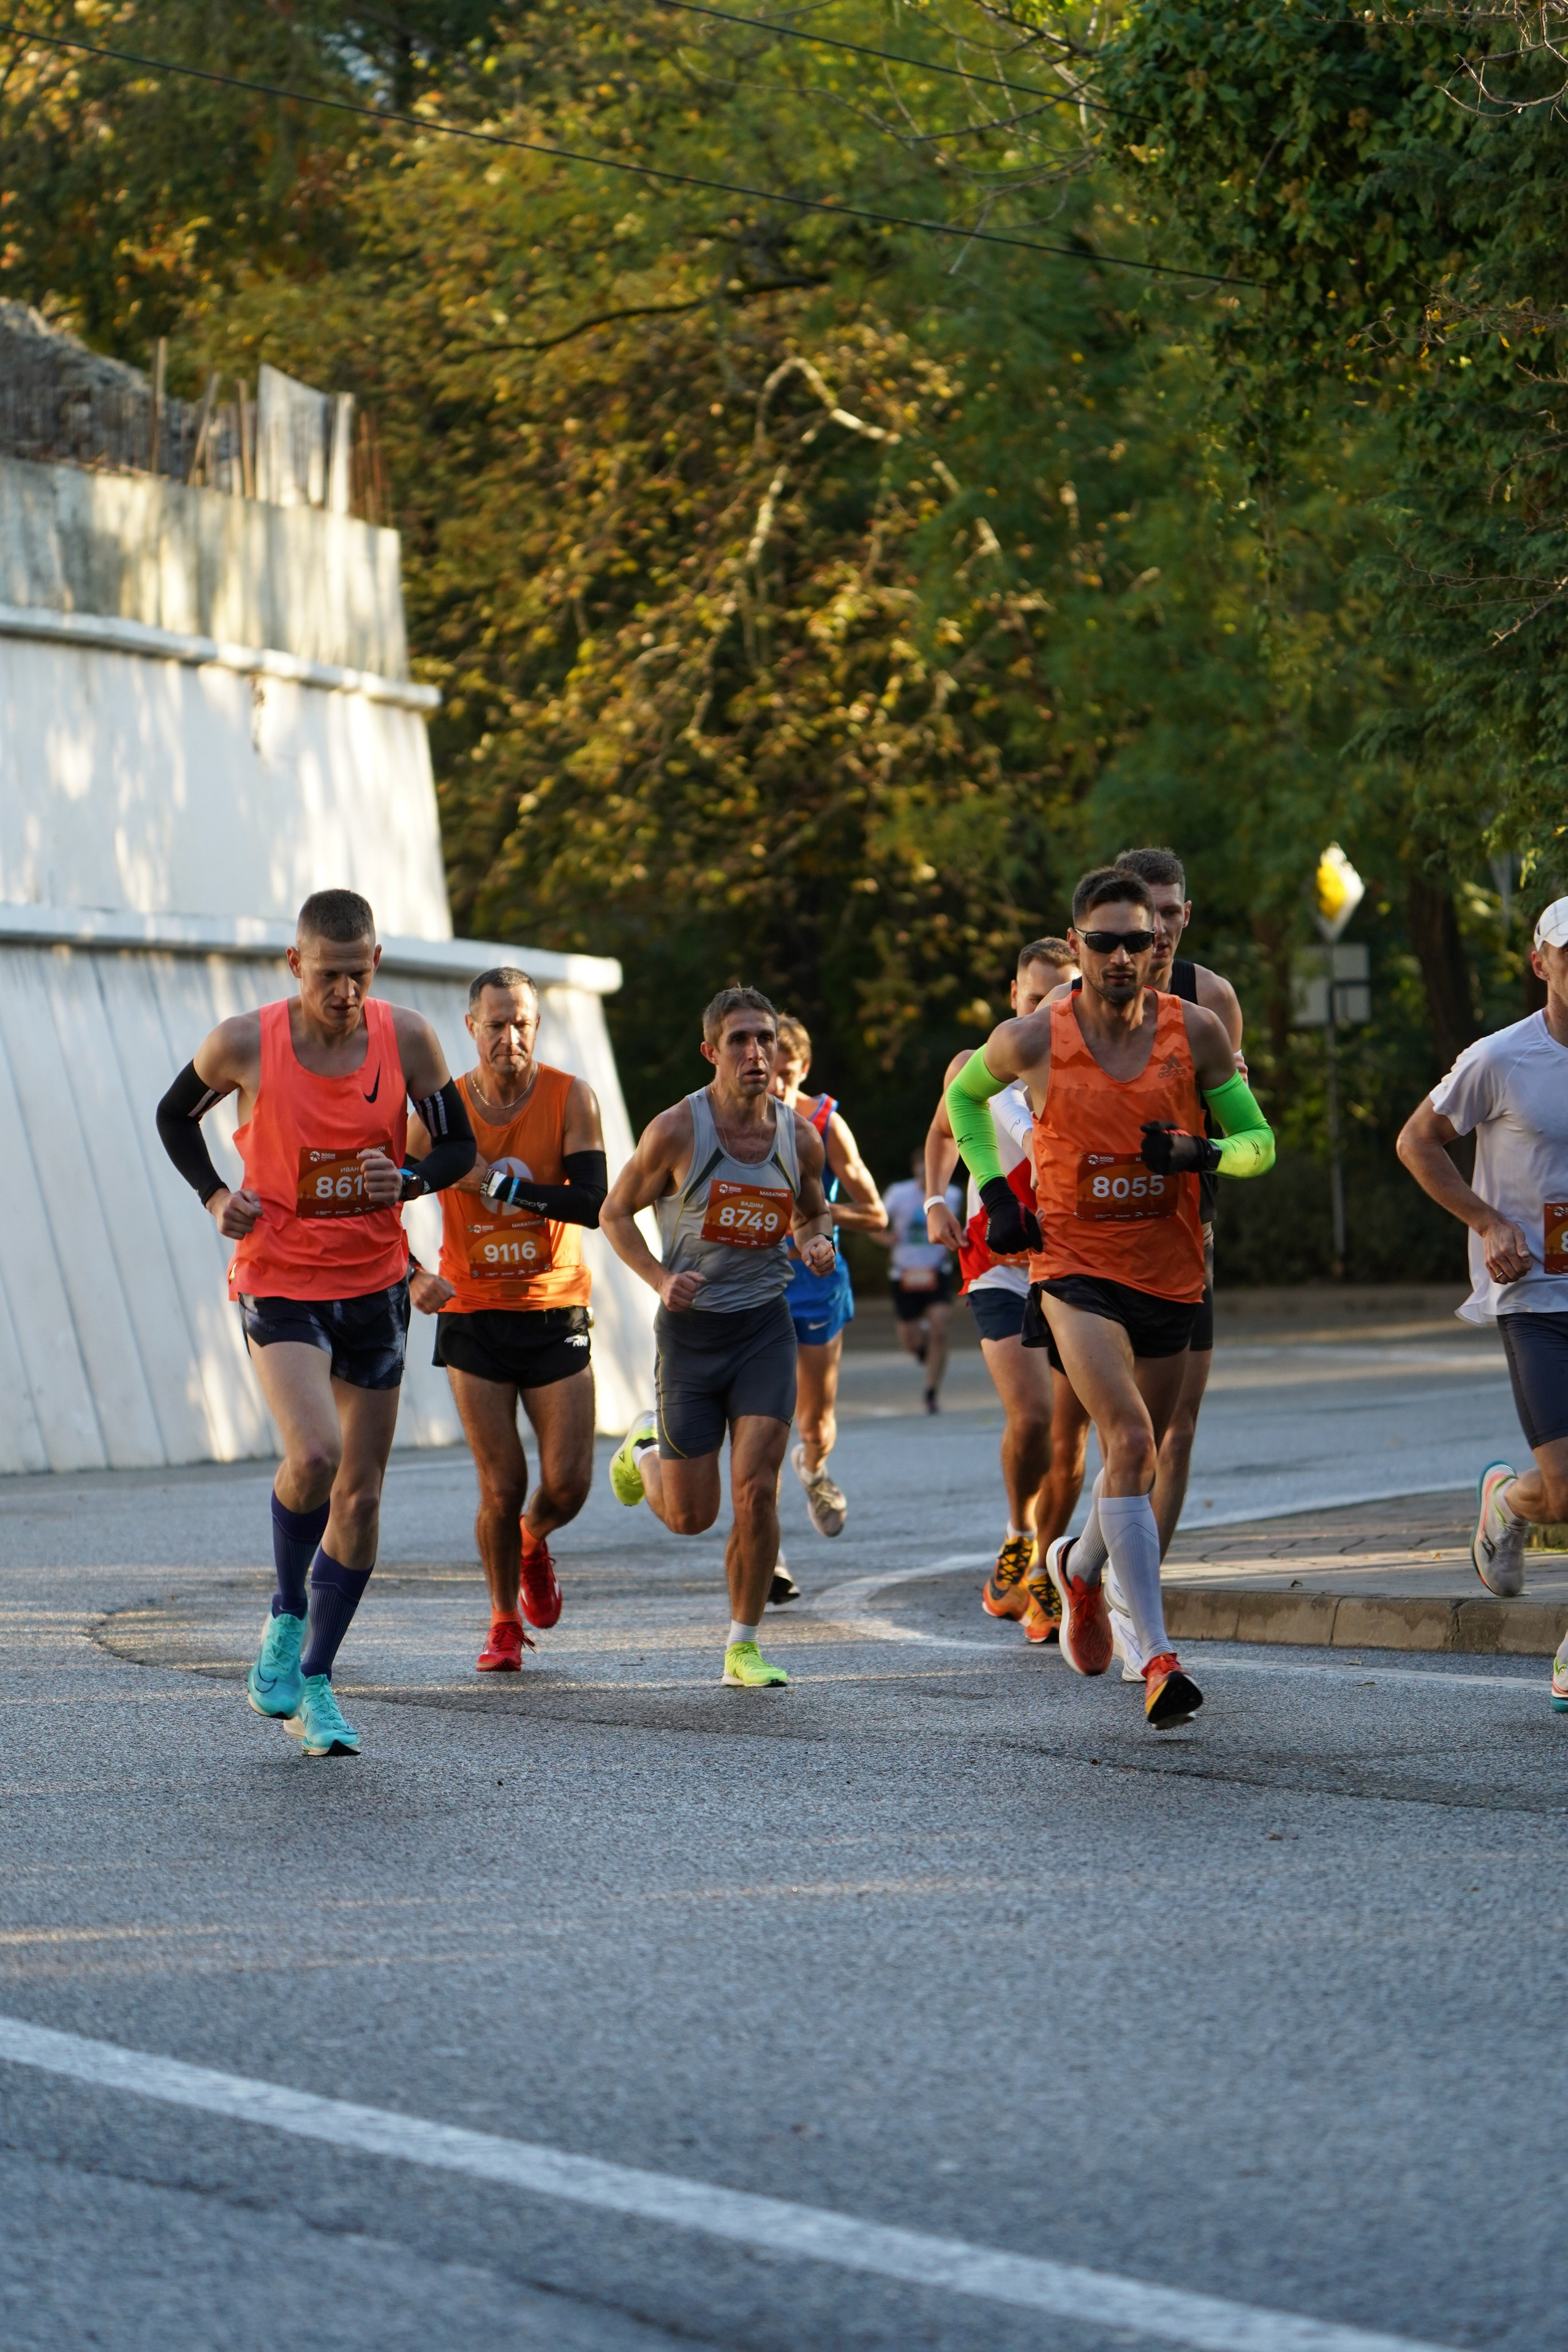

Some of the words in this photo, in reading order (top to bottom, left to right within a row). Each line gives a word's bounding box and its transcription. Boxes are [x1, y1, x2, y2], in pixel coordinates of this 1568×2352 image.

[1158, 1068, 1187, 1079] adidas
[315, 1174, 363, 1198] 861
[1092, 1175, 1165, 1199] 8055
[719, 1207, 778, 1232] 8749
[484, 1241, 536, 1263] 9116
